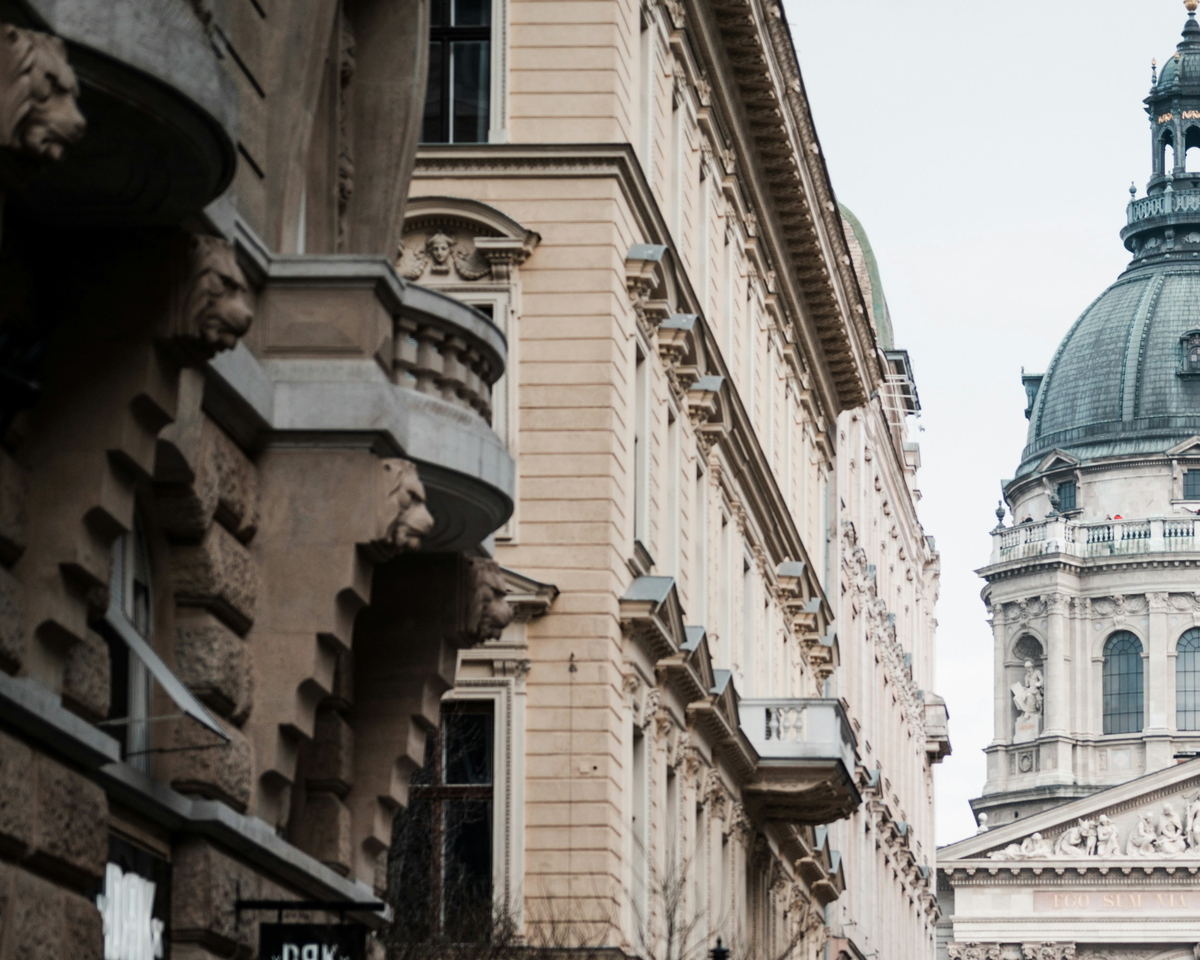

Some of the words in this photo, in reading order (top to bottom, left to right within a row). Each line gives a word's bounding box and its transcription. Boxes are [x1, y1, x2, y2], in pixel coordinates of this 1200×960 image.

[1053, 893, 1090, 909] EGO
[1102, 893, 1142, 908] SUM
[1157, 893, 1188, 908] VIA
